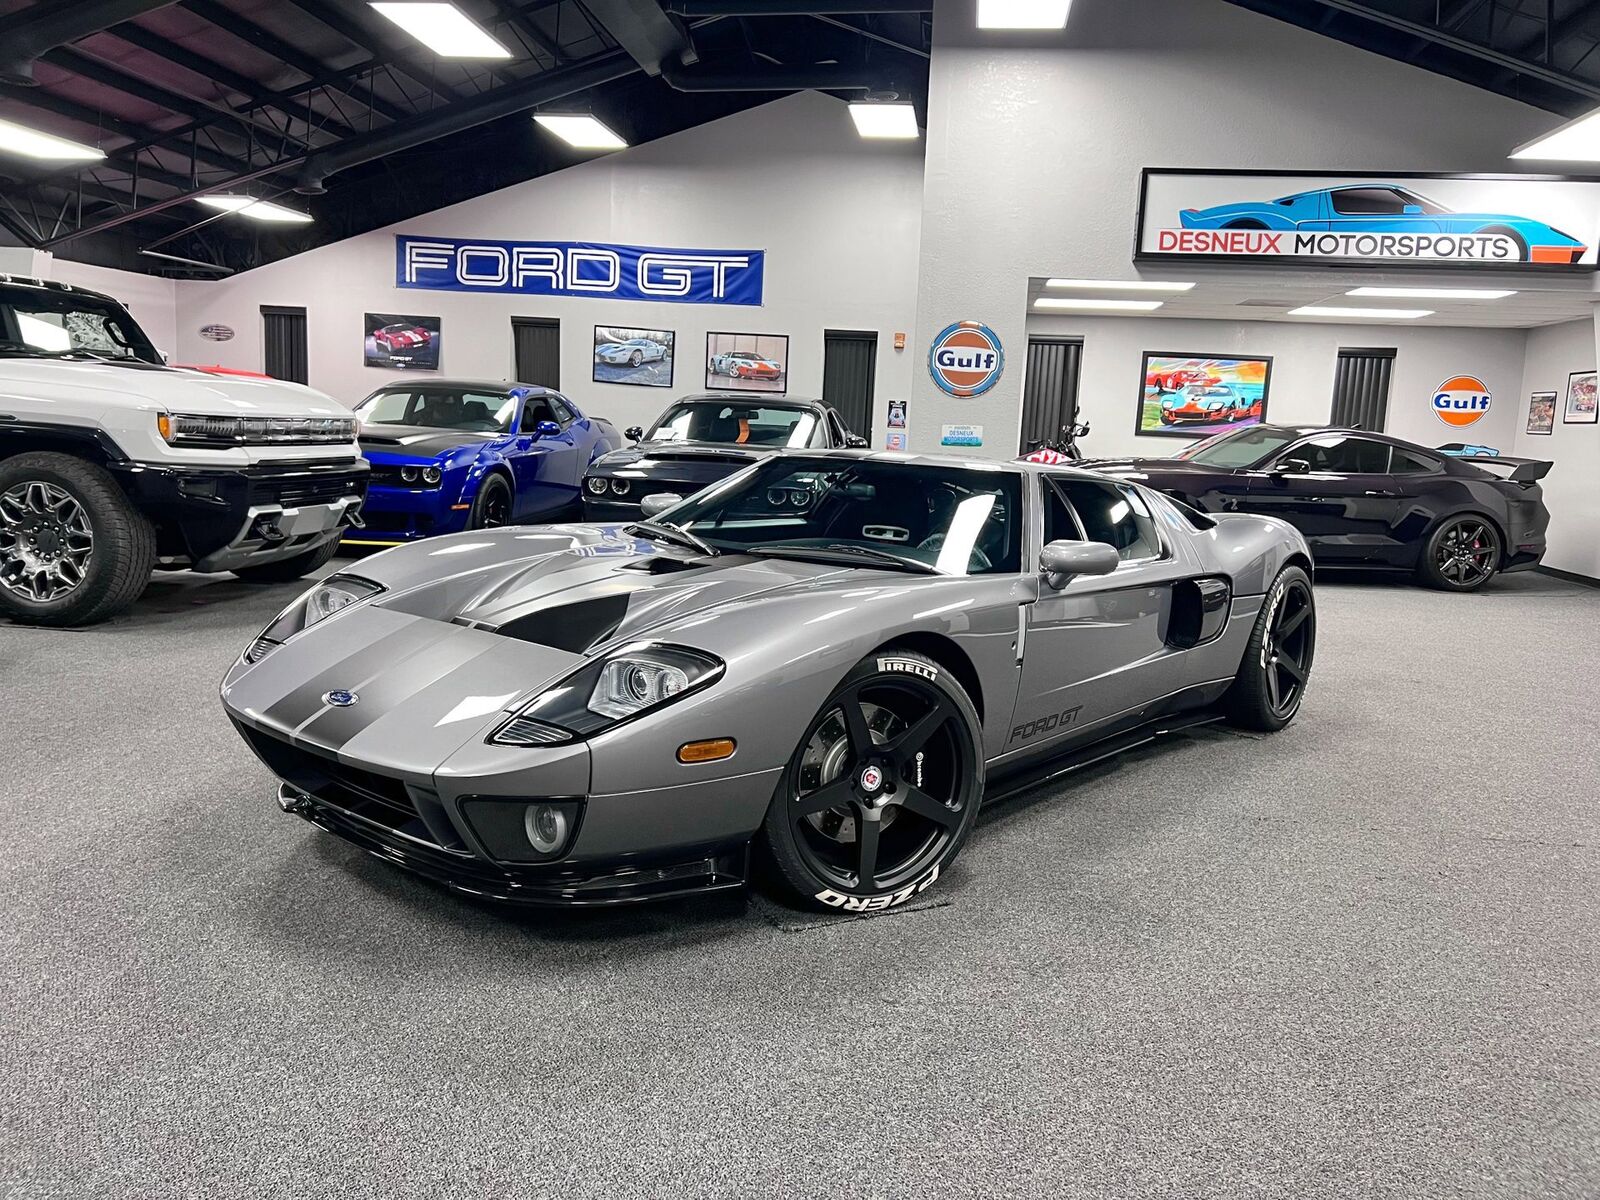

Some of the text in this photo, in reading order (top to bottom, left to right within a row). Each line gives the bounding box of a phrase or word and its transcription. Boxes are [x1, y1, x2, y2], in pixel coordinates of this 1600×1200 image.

[1158, 230, 1509, 259] DESNEUX MOTORSPORTS
[405, 241, 749, 298] FORD GT
[936, 349, 995, 369] Gulf
[1433, 393, 1490, 410] Gulf
[876, 656, 939, 682] PIRELLI
[1009, 704, 1084, 744] FORD GT
[814, 883, 917, 912] ZERO
